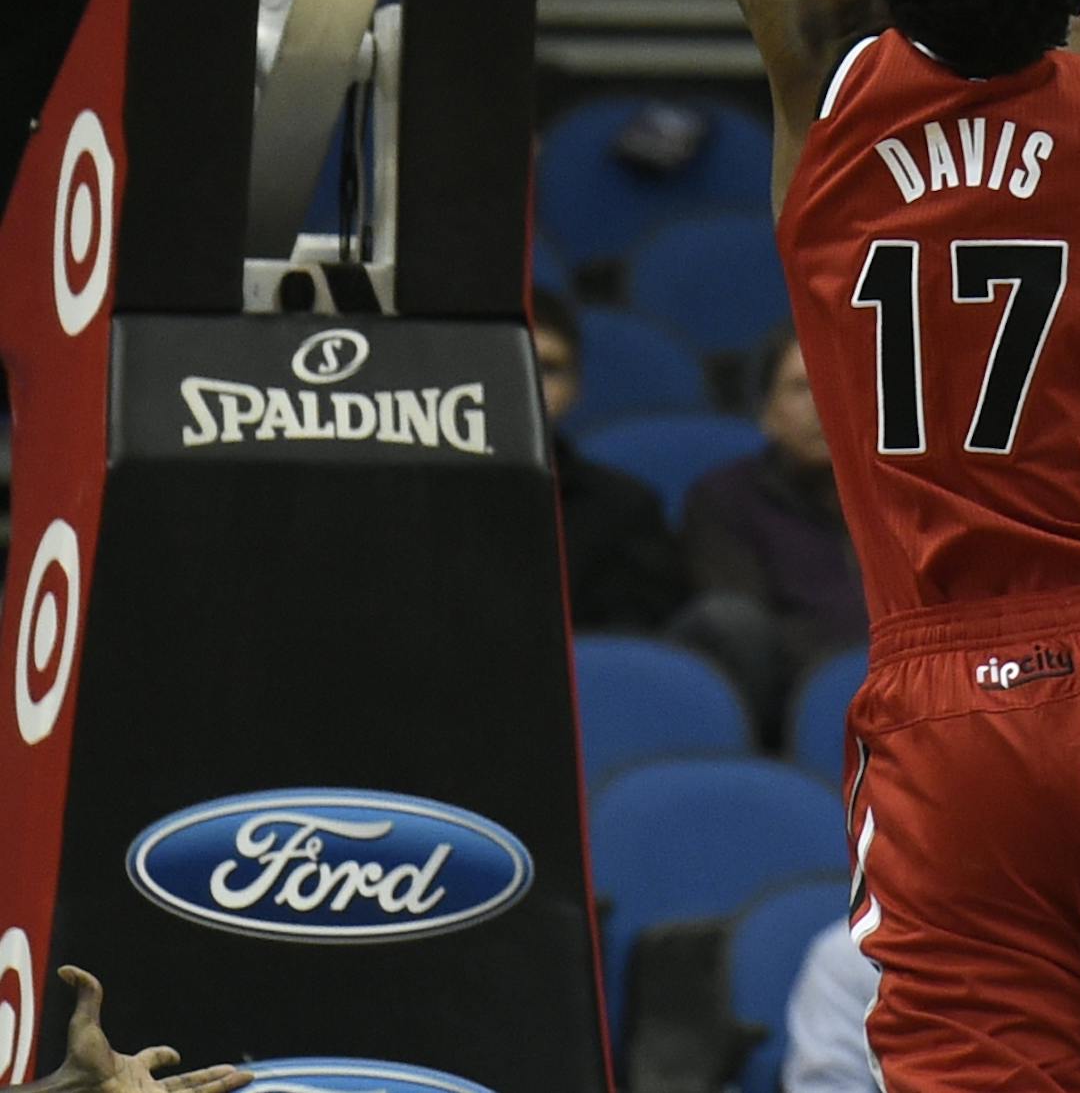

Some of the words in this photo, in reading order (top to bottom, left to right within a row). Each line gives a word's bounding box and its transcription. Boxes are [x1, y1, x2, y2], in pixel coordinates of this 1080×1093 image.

[874, 117, 1054, 204] DAVIS
[851, 239, 1069, 455] 17
[181, 375, 486, 455] SPALDING
[210, 811, 453, 915] Ford
